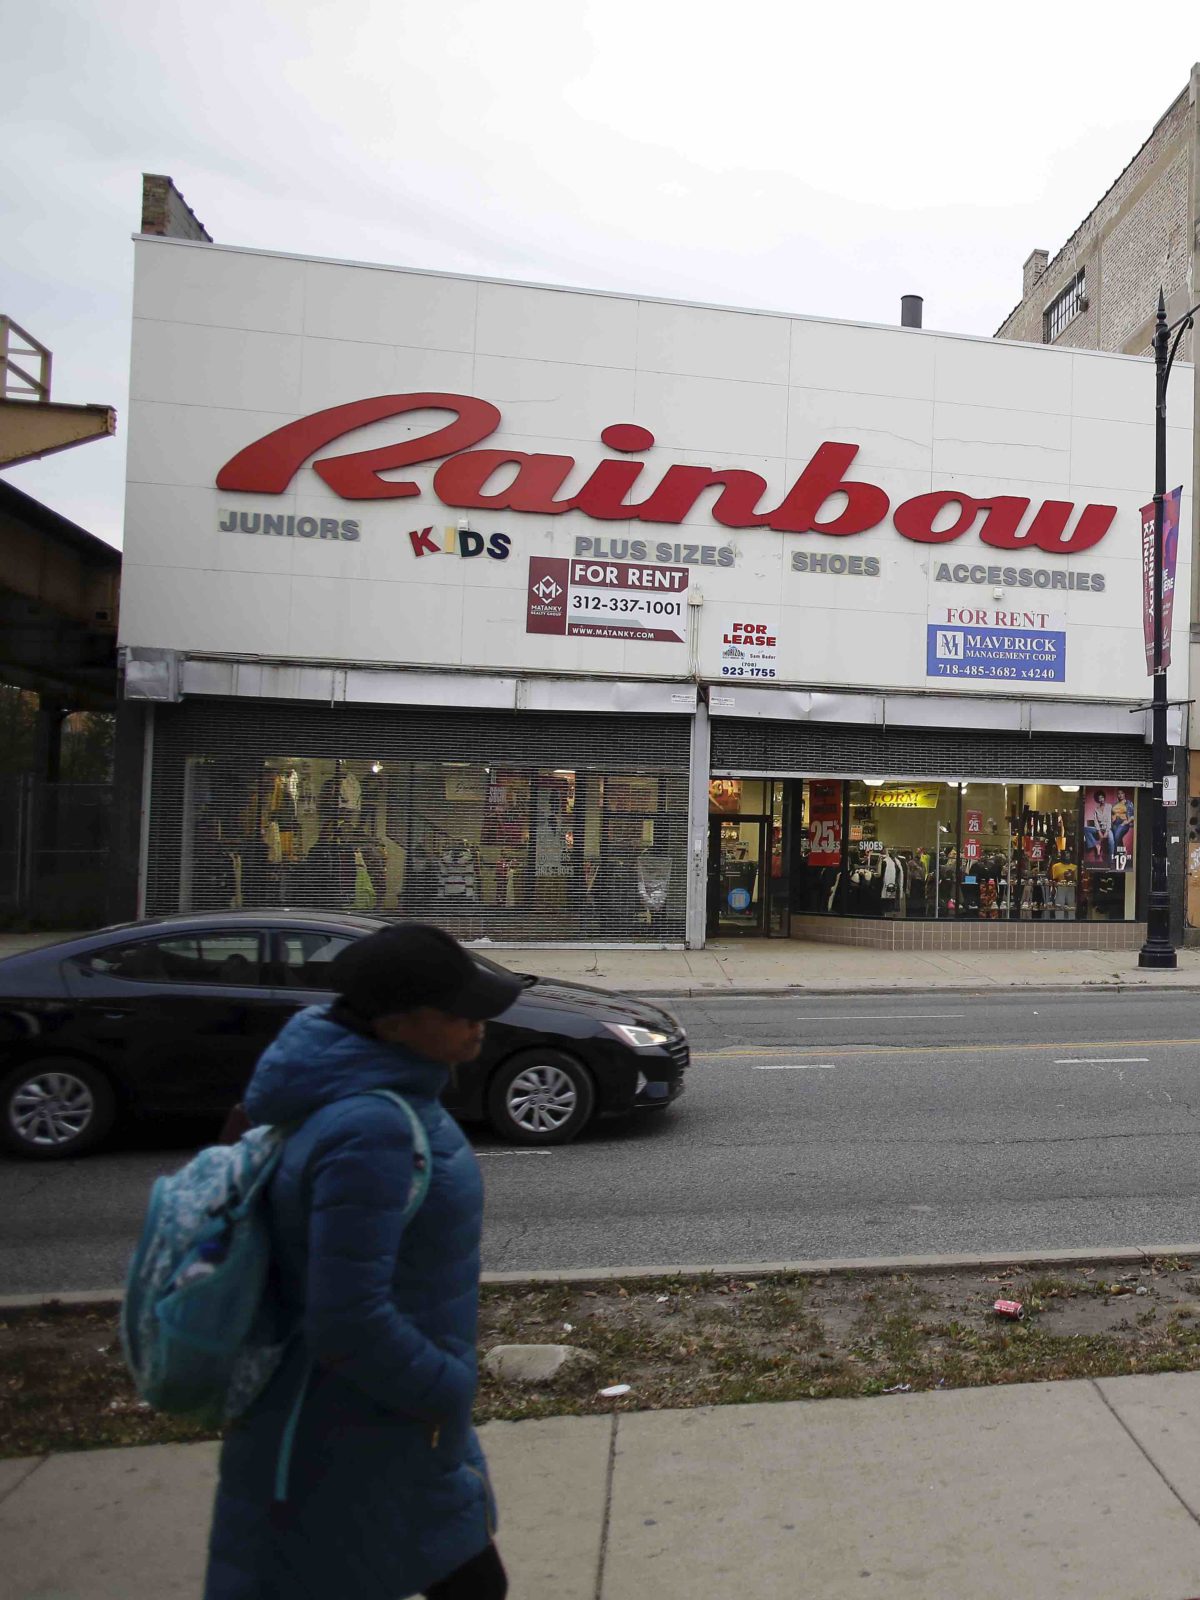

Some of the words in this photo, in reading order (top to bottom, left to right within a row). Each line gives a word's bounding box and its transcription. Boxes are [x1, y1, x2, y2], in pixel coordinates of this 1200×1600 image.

[216, 392, 1117, 554] Rainbow
[219, 511, 360, 541] JUNIORS
[409, 526, 512, 560] KIDS
[575, 537, 647, 560] PLUS
[656, 542, 735, 567] SIZES
[792, 551, 880, 576] SHOES
[574, 564, 618, 584] FOR
[628, 568, 683, 588] RENT
[935, 563, 1106, 592] ACCESSORIES
[573, 595, 681, 615] 312-337-1001
[733, 623, 767, 634] FOR
[947, 608, 988, 625] FOR
[995, 611, 1049, 629] RENT
[572, 627, 655, 639] WWW.MATANKY.COM
[723, 634, 776, 646] LEASE
[966, 635, 1056, 652] MAVERICK
[966, 650, 1031, 660] MANAGEMENT
[722, 667, 776, 677] 923-1755
[938, 664, 1017, 677] 718-485-3682
[1021, 668, 1055, 679] x4240
[859, 840, 884, 851] SHOES
